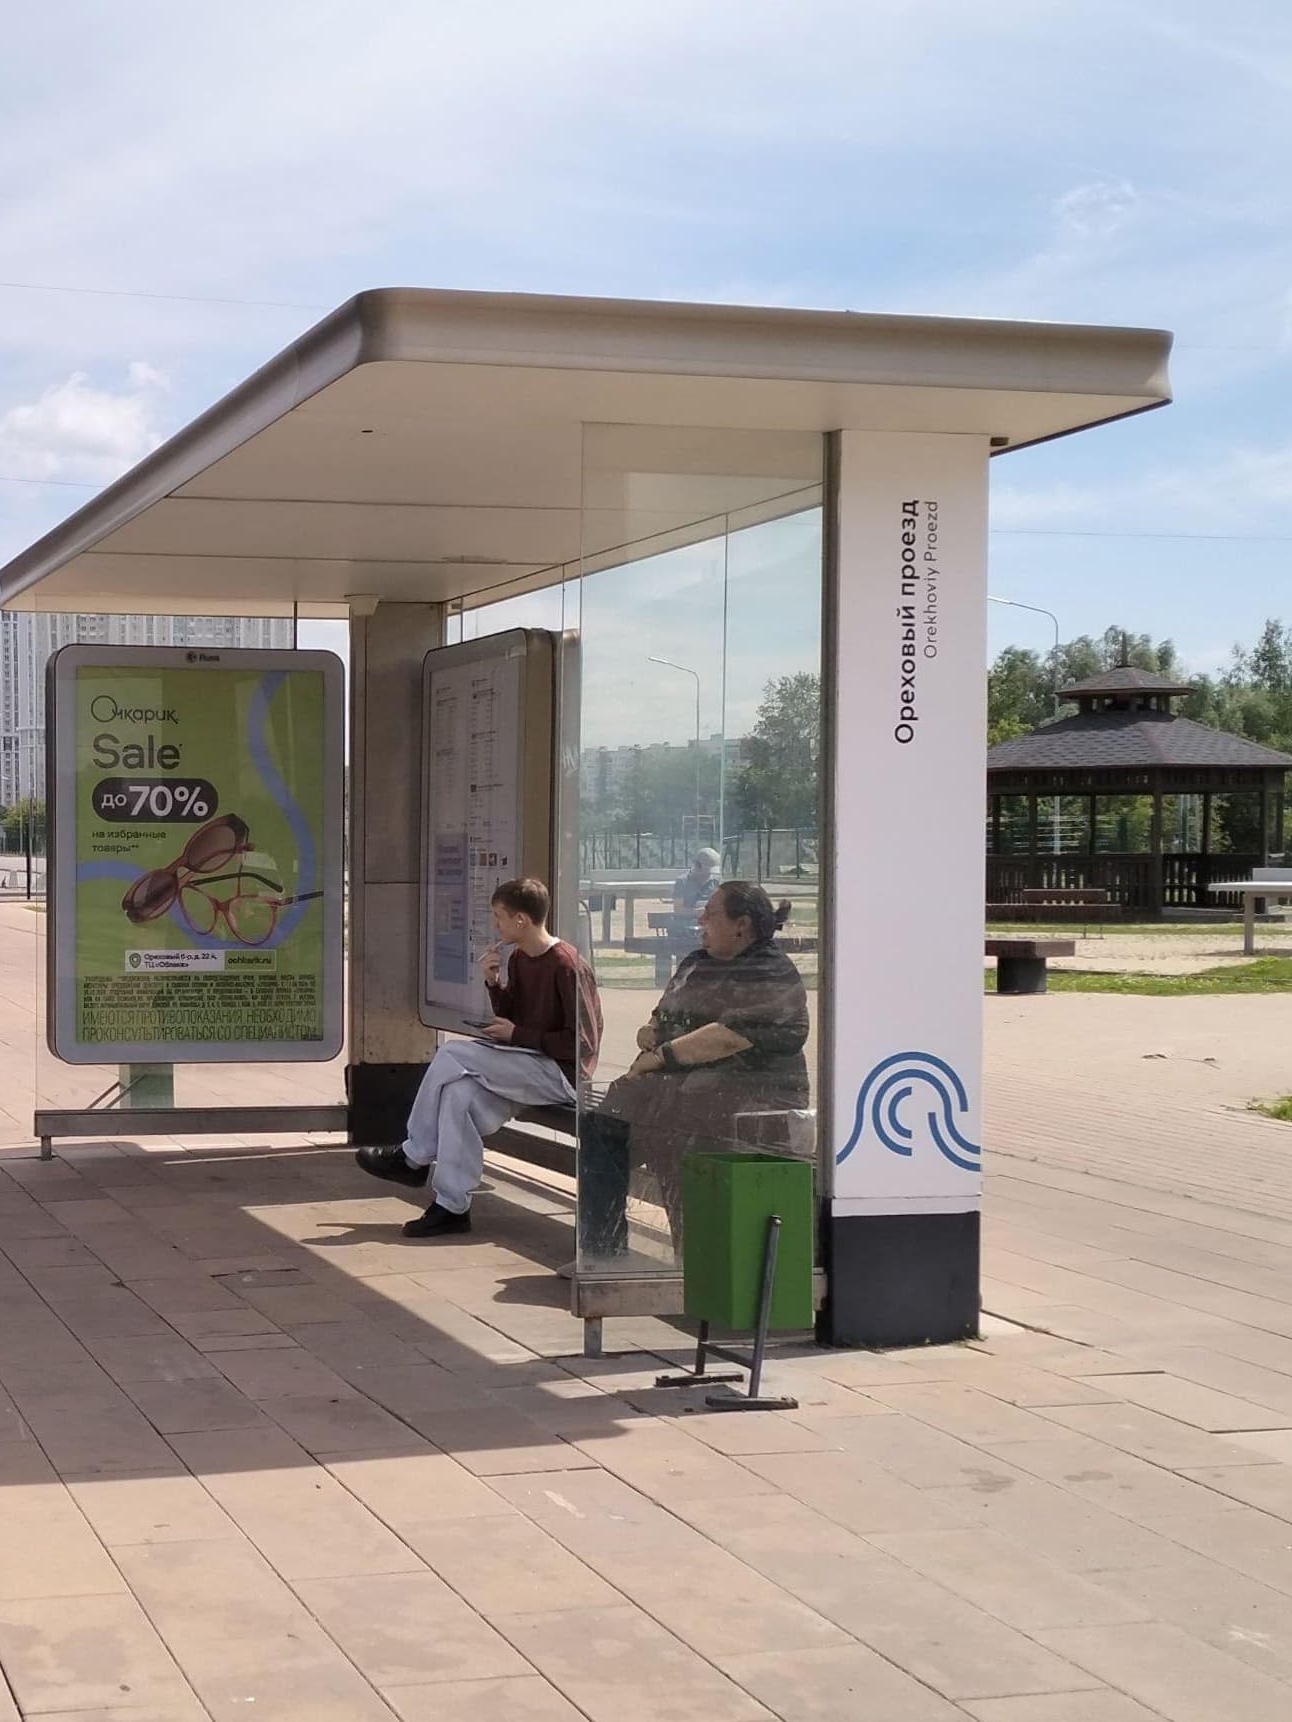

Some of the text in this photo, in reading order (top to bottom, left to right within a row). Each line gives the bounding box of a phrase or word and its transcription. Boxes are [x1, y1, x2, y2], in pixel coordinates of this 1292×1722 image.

[923, 501, 940, 659] Orekhoviy Proezd
[894, 500, 920, 744] Ореховый проезд
[101, 785, 209, 817] до 70%
[92, 830, 167, 841] на избранные
[83, 1010, 135, 1025] ИМЕЮТСЯ
